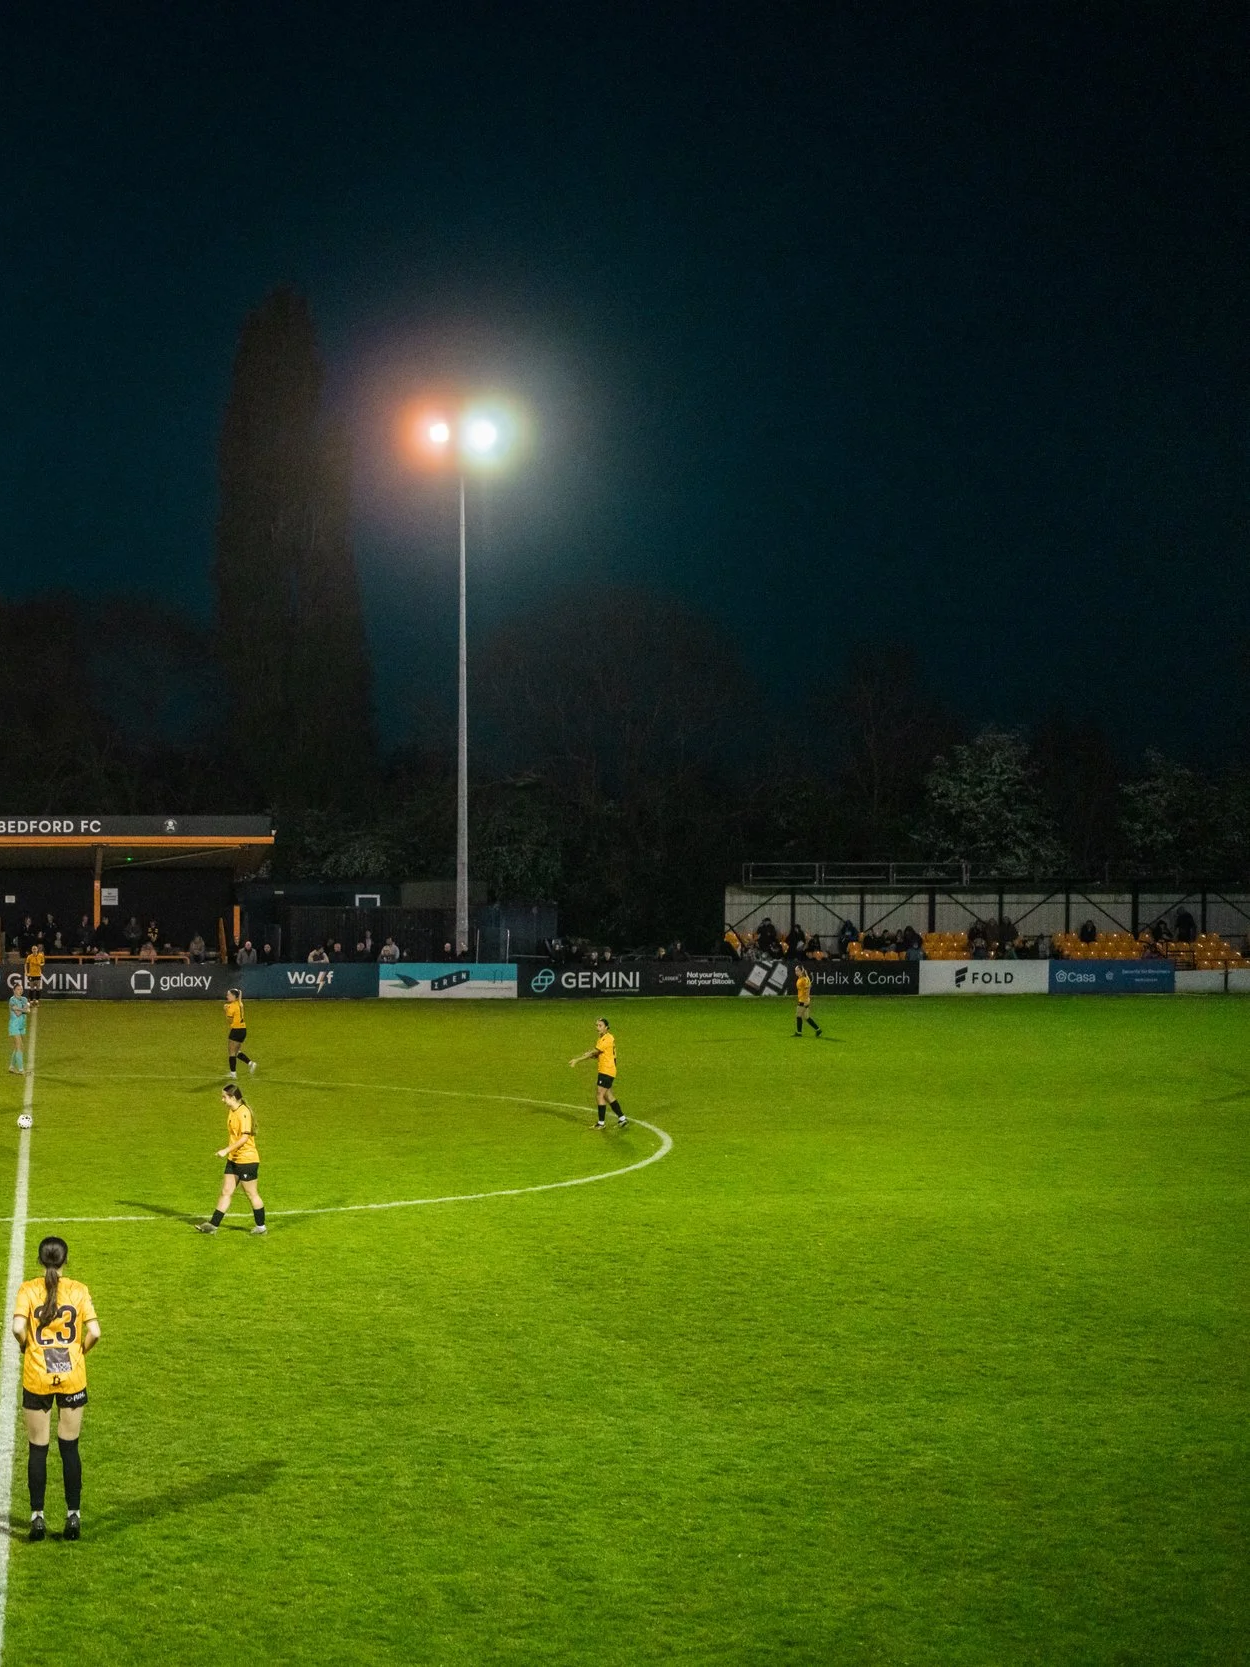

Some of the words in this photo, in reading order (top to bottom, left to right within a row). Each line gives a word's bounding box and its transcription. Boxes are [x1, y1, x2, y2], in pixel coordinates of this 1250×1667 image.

[80, 820, 101, 833] FC
[160, 972, 212, 991] galaxy
[434, 972, 467, 989] IREN
[561, 971, 640, 988] GEMINI
[713, 971, 729, 979] keys,
[816, 971, 849, 985] Helix
[853, 972, 863, 985] &
[867, 971, 910, 985] Conch
[971, 972, 1014, 984] FOLD
[1067, 972, 1096, 983] Casa
[34, 1304, 77, 1346] 23
